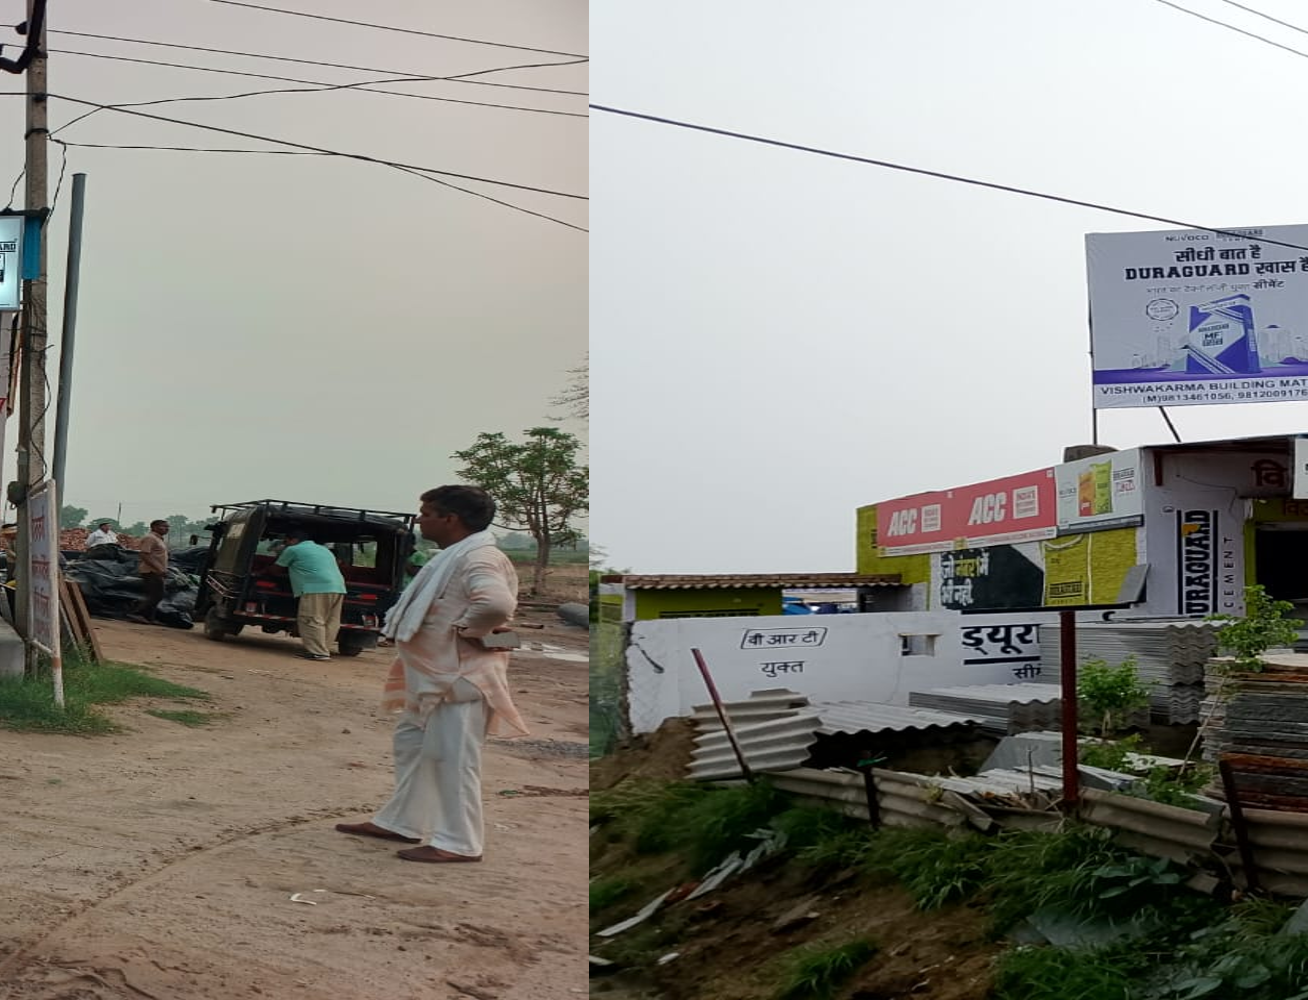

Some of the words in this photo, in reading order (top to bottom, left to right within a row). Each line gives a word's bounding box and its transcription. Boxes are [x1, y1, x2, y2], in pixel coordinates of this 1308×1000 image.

[1175, 246, 1216, 264] सीधी
[1218, 247, 1247, 263] बात
[1250, 244, 1262, 260] है
[1125, 261, 1251, 283] DURAGUARD
[1100, 382, 1206, 398] VISHWAKARMA
[1209, 379, 1276, 394] BUILDING
[967, 491, 1007, 526] ACC
[887, 508, 918, 537] ACC
[1223, 536, 1234, 608] CEMENT
[759, 659, 805, 678] युक्त
